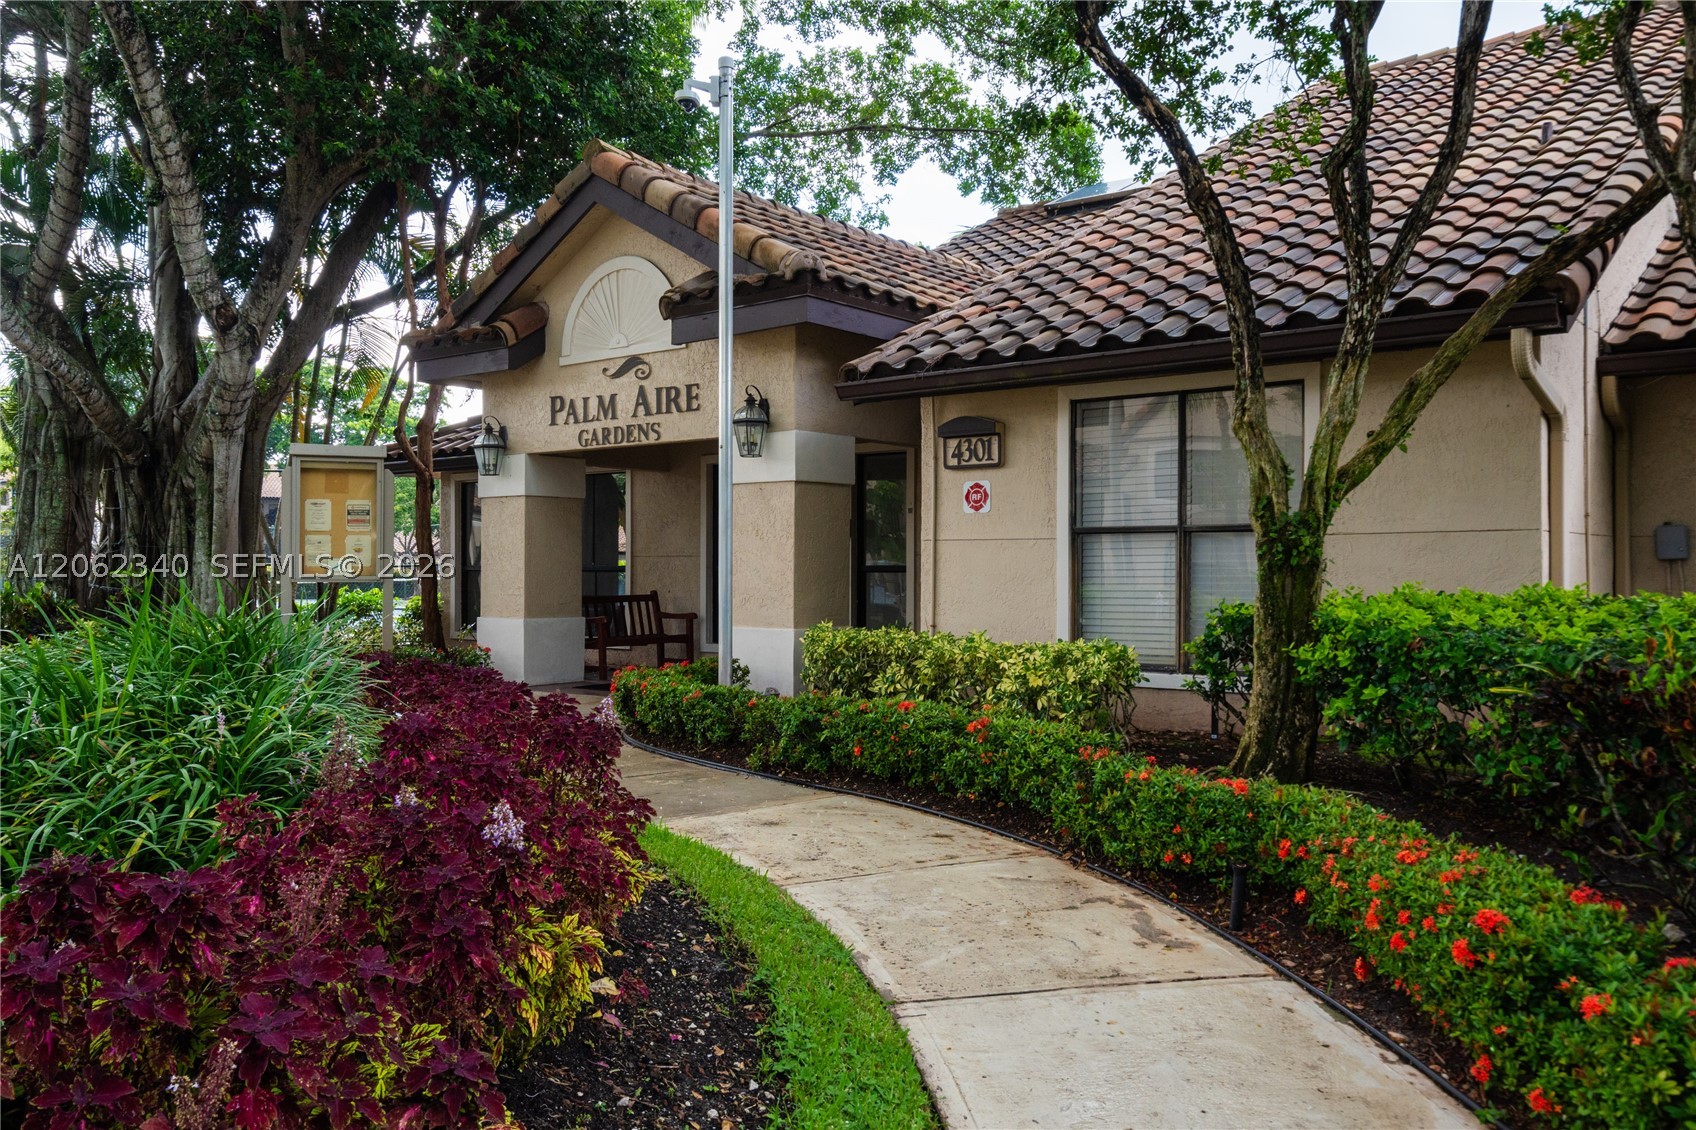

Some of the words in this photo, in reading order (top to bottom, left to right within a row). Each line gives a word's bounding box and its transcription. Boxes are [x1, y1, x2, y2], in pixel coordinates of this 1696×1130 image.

[549, 393, 618, 426] PALM
[631, 383, 700, 418] AIRE
[578, 422, 661, 447] GARDENS
[951, 437, 994, 465] 4301
[971, 493, 982, 501] RF
